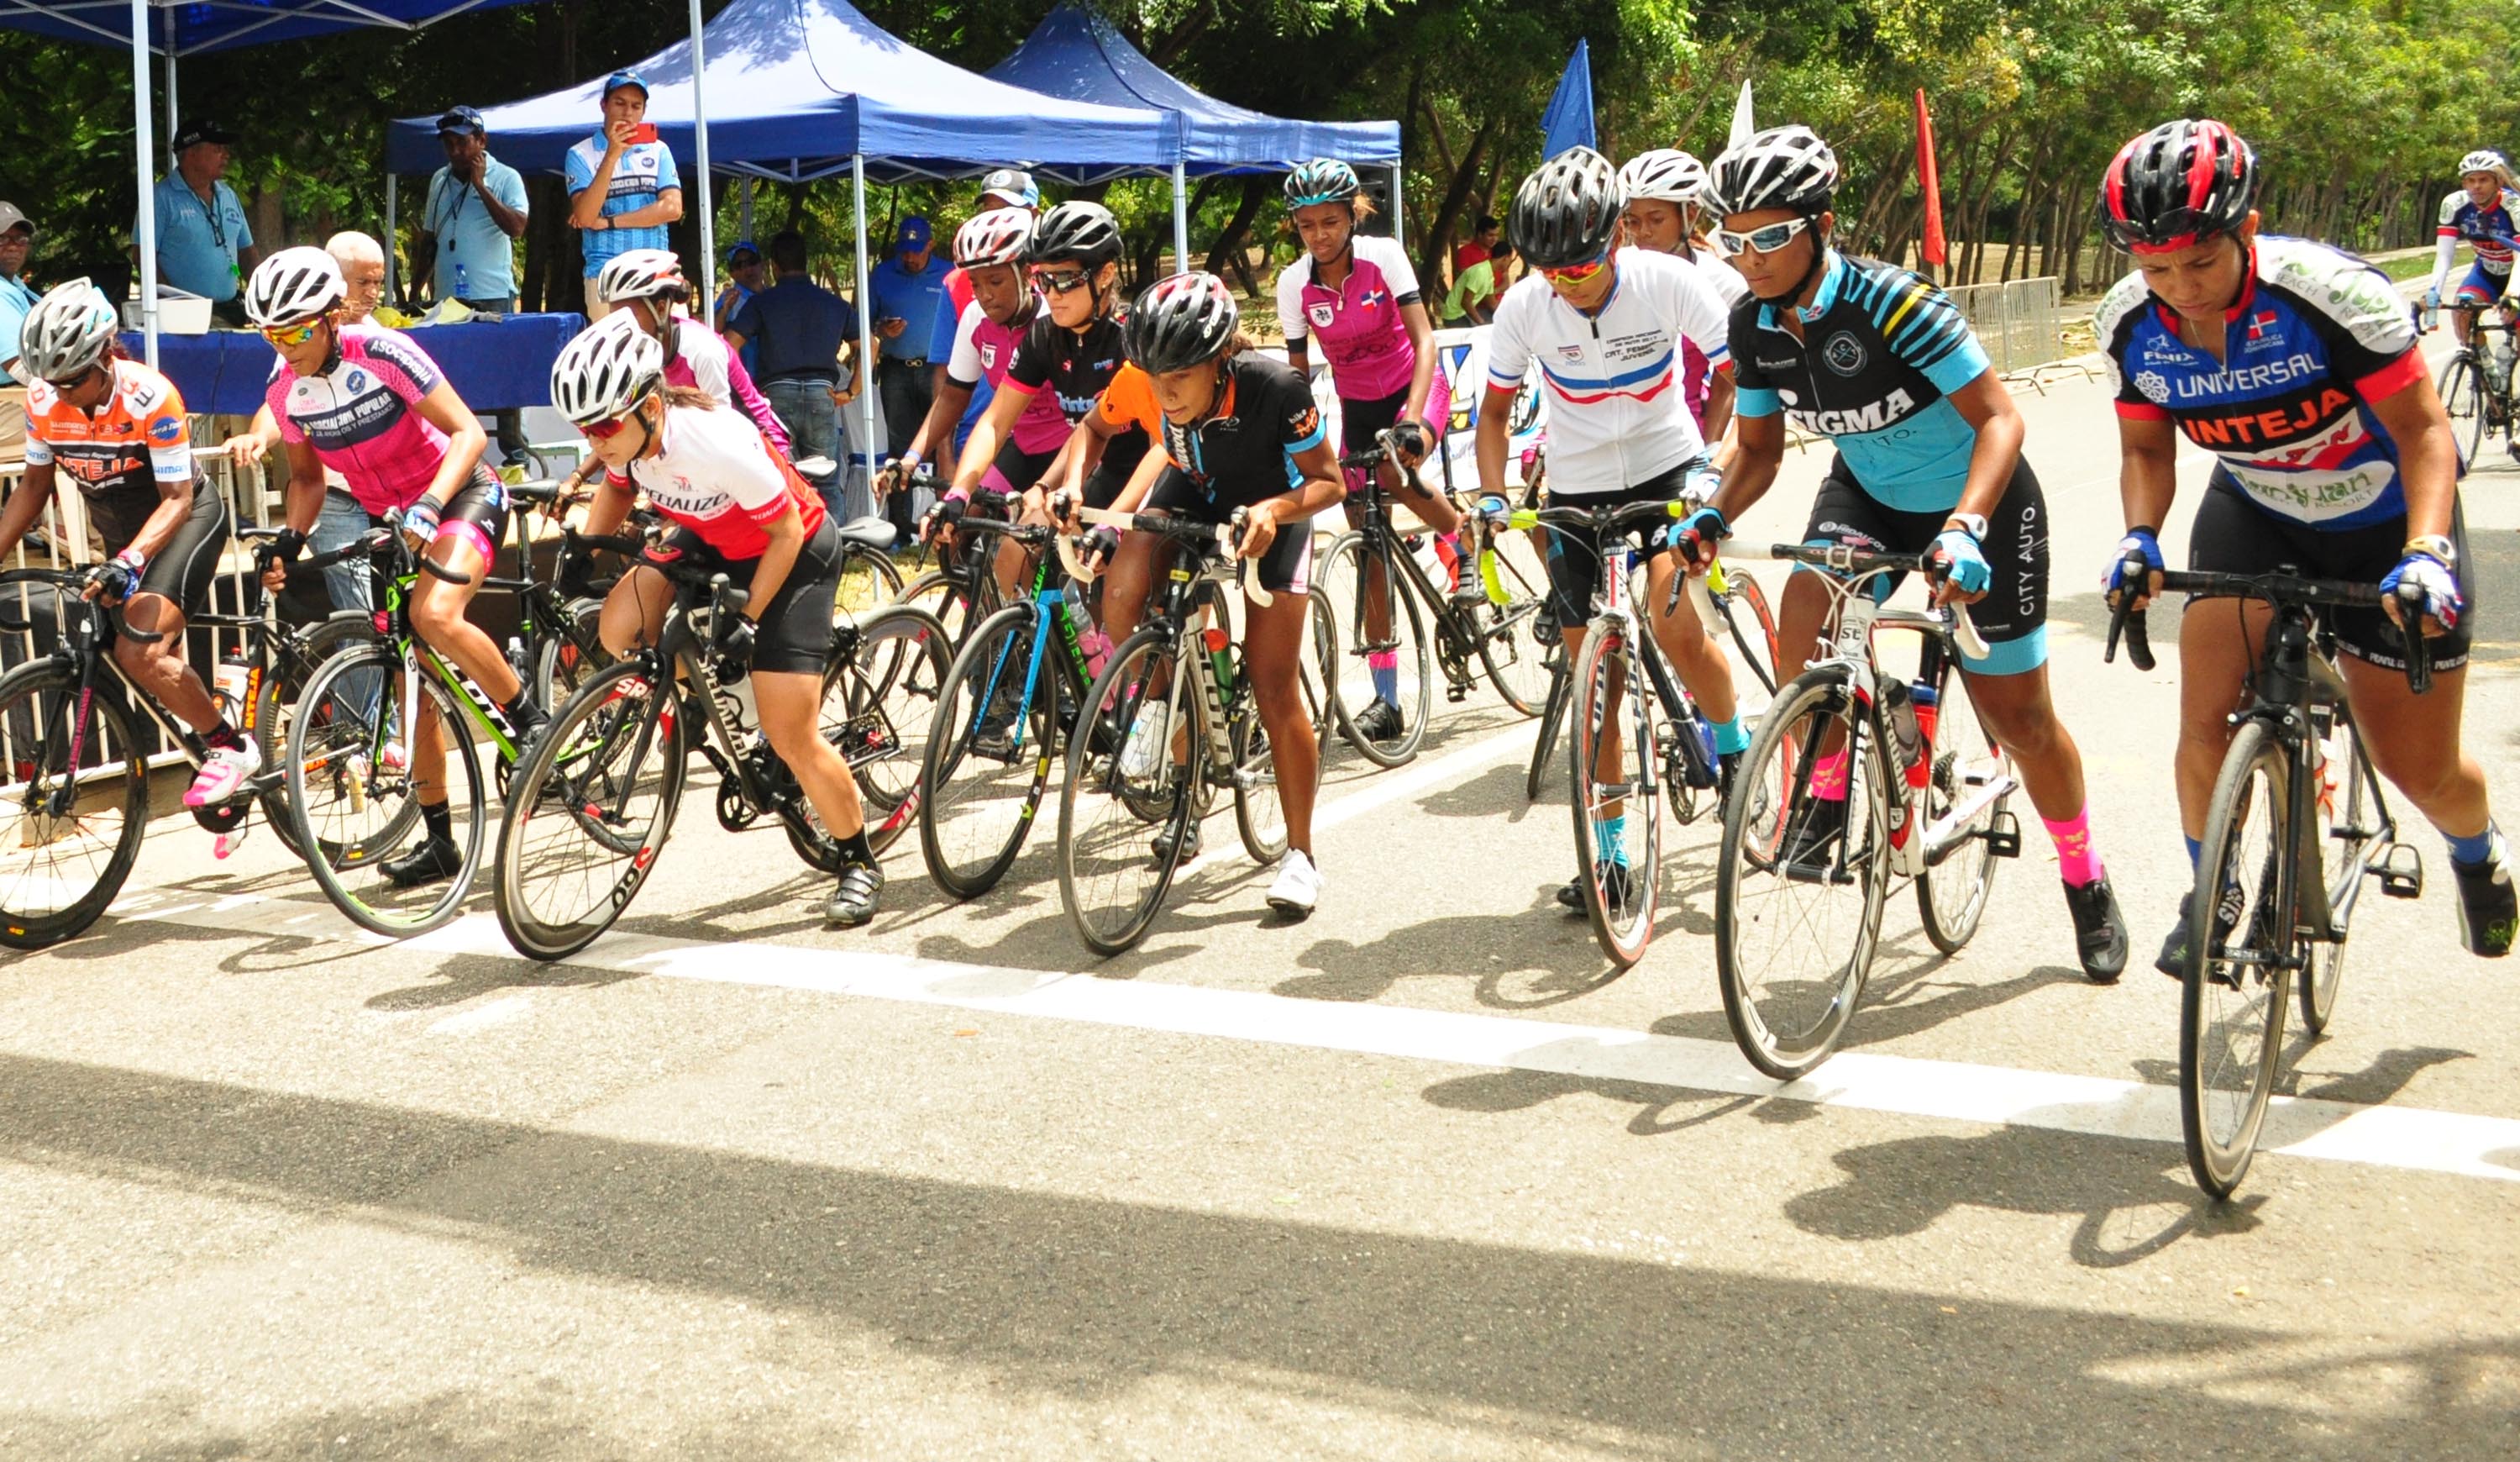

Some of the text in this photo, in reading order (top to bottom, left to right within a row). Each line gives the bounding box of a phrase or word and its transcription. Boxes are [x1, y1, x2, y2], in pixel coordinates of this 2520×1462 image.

[1604, 349, 1624, 359] CAT.
[2176, 353, 2325, 398] UNIVERSAL
[354, 392, 392, 419] POPULAR
[1784, 387, 1915, 435] SIGMA
[2185, 388, 2351, 444] INTEJA
[2315, 487, 2374, 508] RORT
[2019, 571, 2035, 615] CITY
[244, 666, 262, 729] INTEJA
[696, 652, 751, 761] SPECIALIZED
